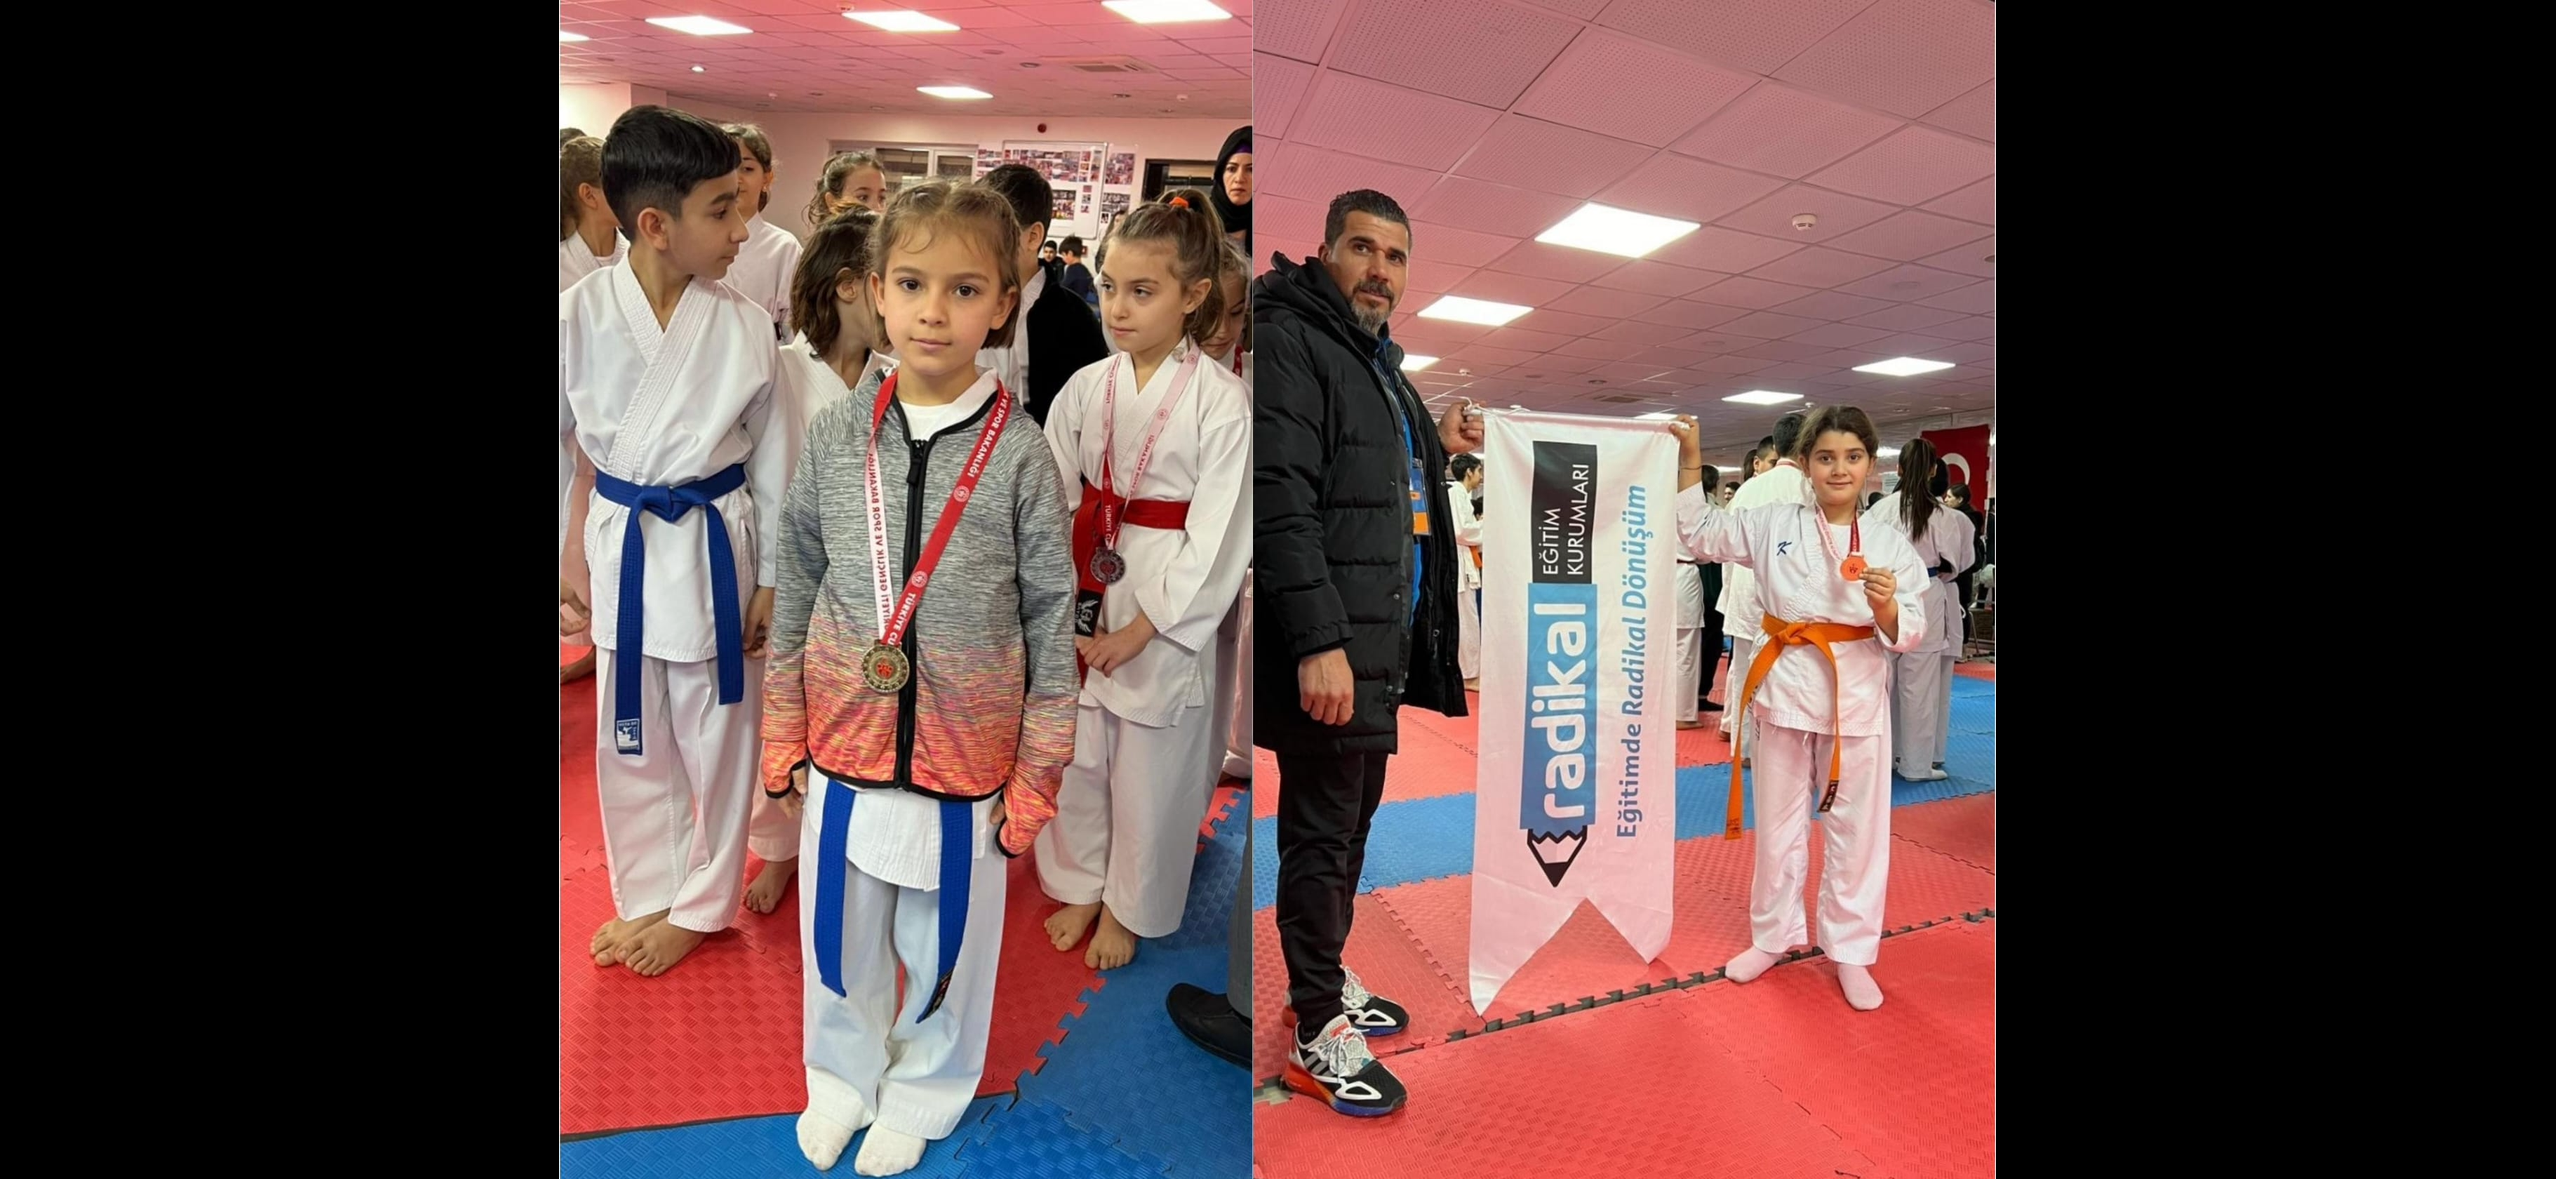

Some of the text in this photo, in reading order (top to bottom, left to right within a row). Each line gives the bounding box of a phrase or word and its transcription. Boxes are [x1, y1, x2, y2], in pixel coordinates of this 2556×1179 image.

[991, 407, 1004, 428] SPOR
[967, 429, 996, 478] BAKANLIĞI
[1538, 508, 1561, 575] EĞİTİM
[1567, 464, 1589, 575] KURUMLARI
[893, 592, 916, 631] TÜRKİYE
[1616, 485, 1654, 838] Eğitimde Radikal Dönüşüm
[1531, 603, 1586, 819] radikal
